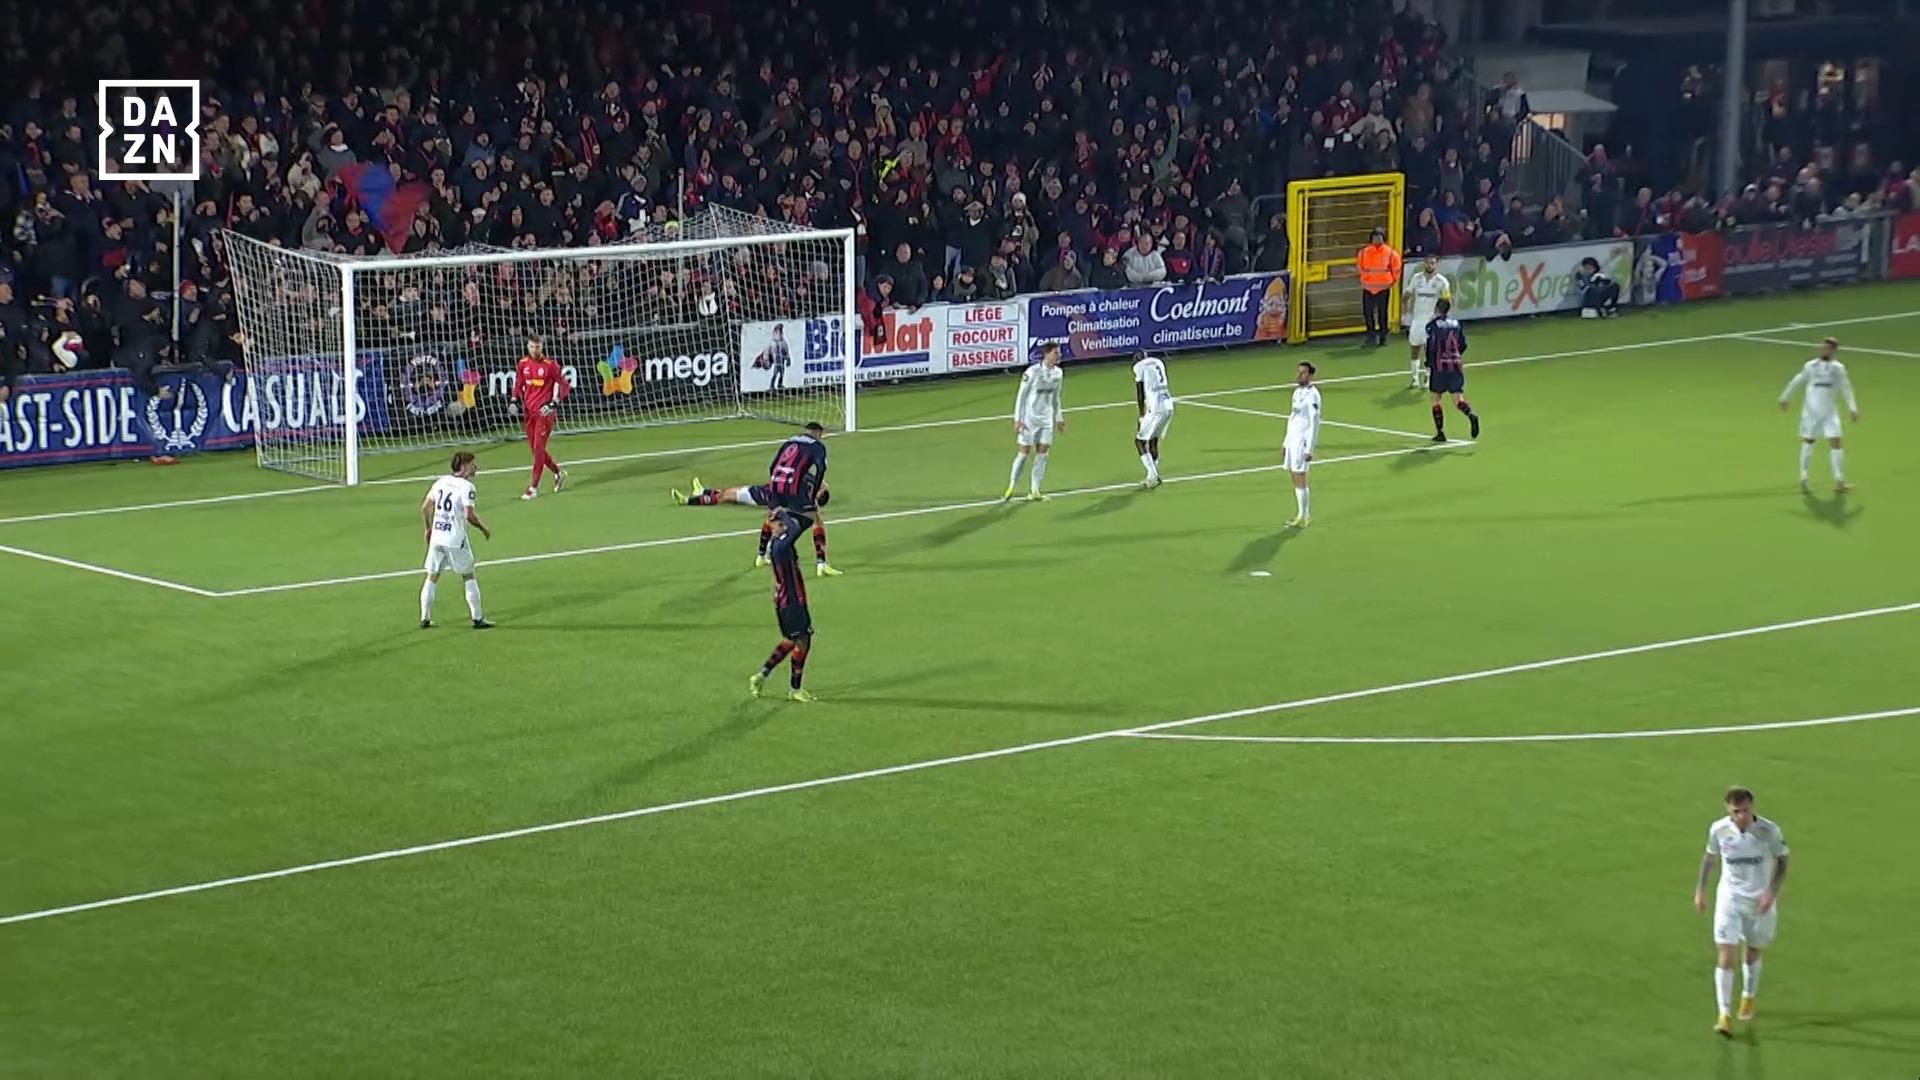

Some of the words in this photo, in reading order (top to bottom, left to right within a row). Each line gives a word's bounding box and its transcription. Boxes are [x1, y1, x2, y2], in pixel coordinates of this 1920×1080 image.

[1041, 303, 1087, 318] Pompes
[1098, 297, 1140, 312] chaleur
[1150, 285, 1250, 322] Coelmont
[1068, 315, 1140, 334] Climatisation
[1153, 322, 1243, 344] climatiseur.be
[952, 327, 1014, 346] ROCOURT
[1081, 334, 1140, 351] Ventilation
[952, 348, 1015, 367] BASSENGE
[645, 351, 728, 387] mega
[489, 365, 578, 397] ma
[436, 489, 453, 512] 26
